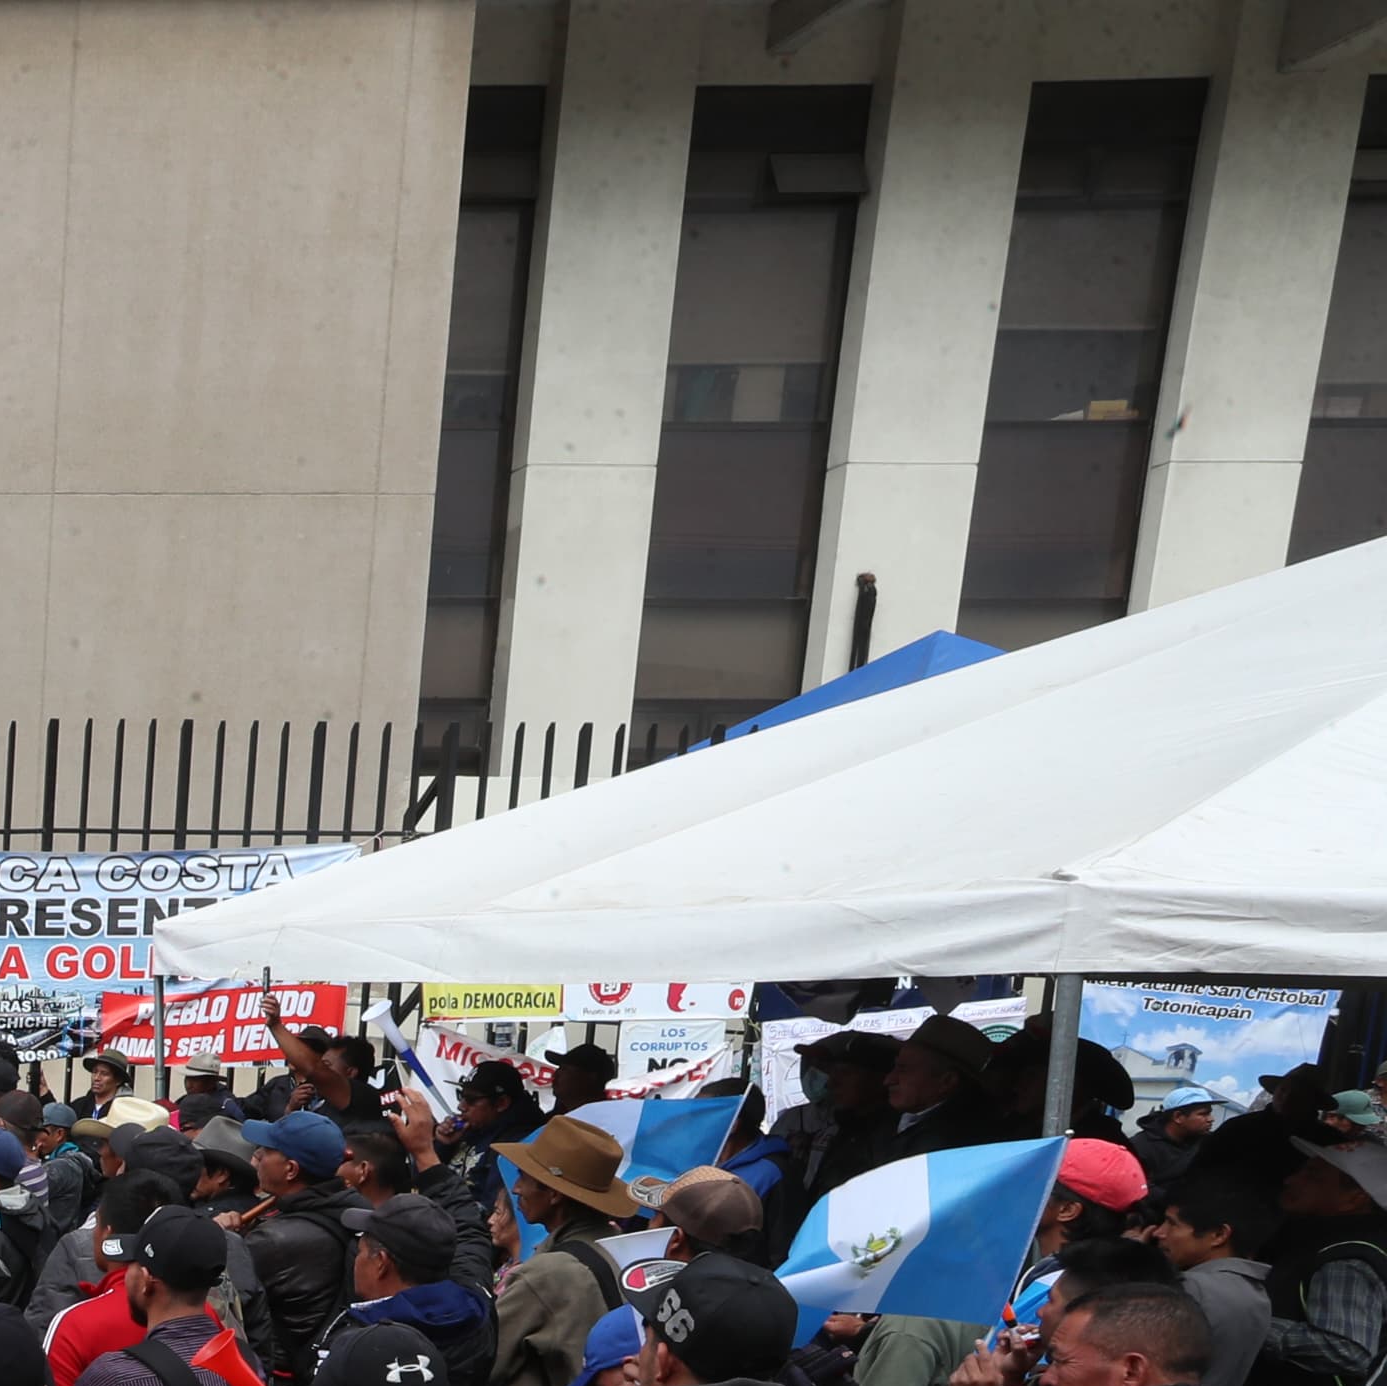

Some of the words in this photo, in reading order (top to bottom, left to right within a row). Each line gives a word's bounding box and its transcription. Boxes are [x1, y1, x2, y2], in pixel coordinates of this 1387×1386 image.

[96, 853, 294, 891] COSTA
[463, 991, 557, 1010] DEMOCRACIA
[1208, 984, 1242, 998] San
[1245, 986, 1327, 1007] Cristobal
[1142, 997, 1253, 1021] Totonicapán
[175, 1027, 227, 1058] SERÁ
[660, 1028, 687, 1038] LOS
[629, 1041, 709, 1052] CORRUPTOS
